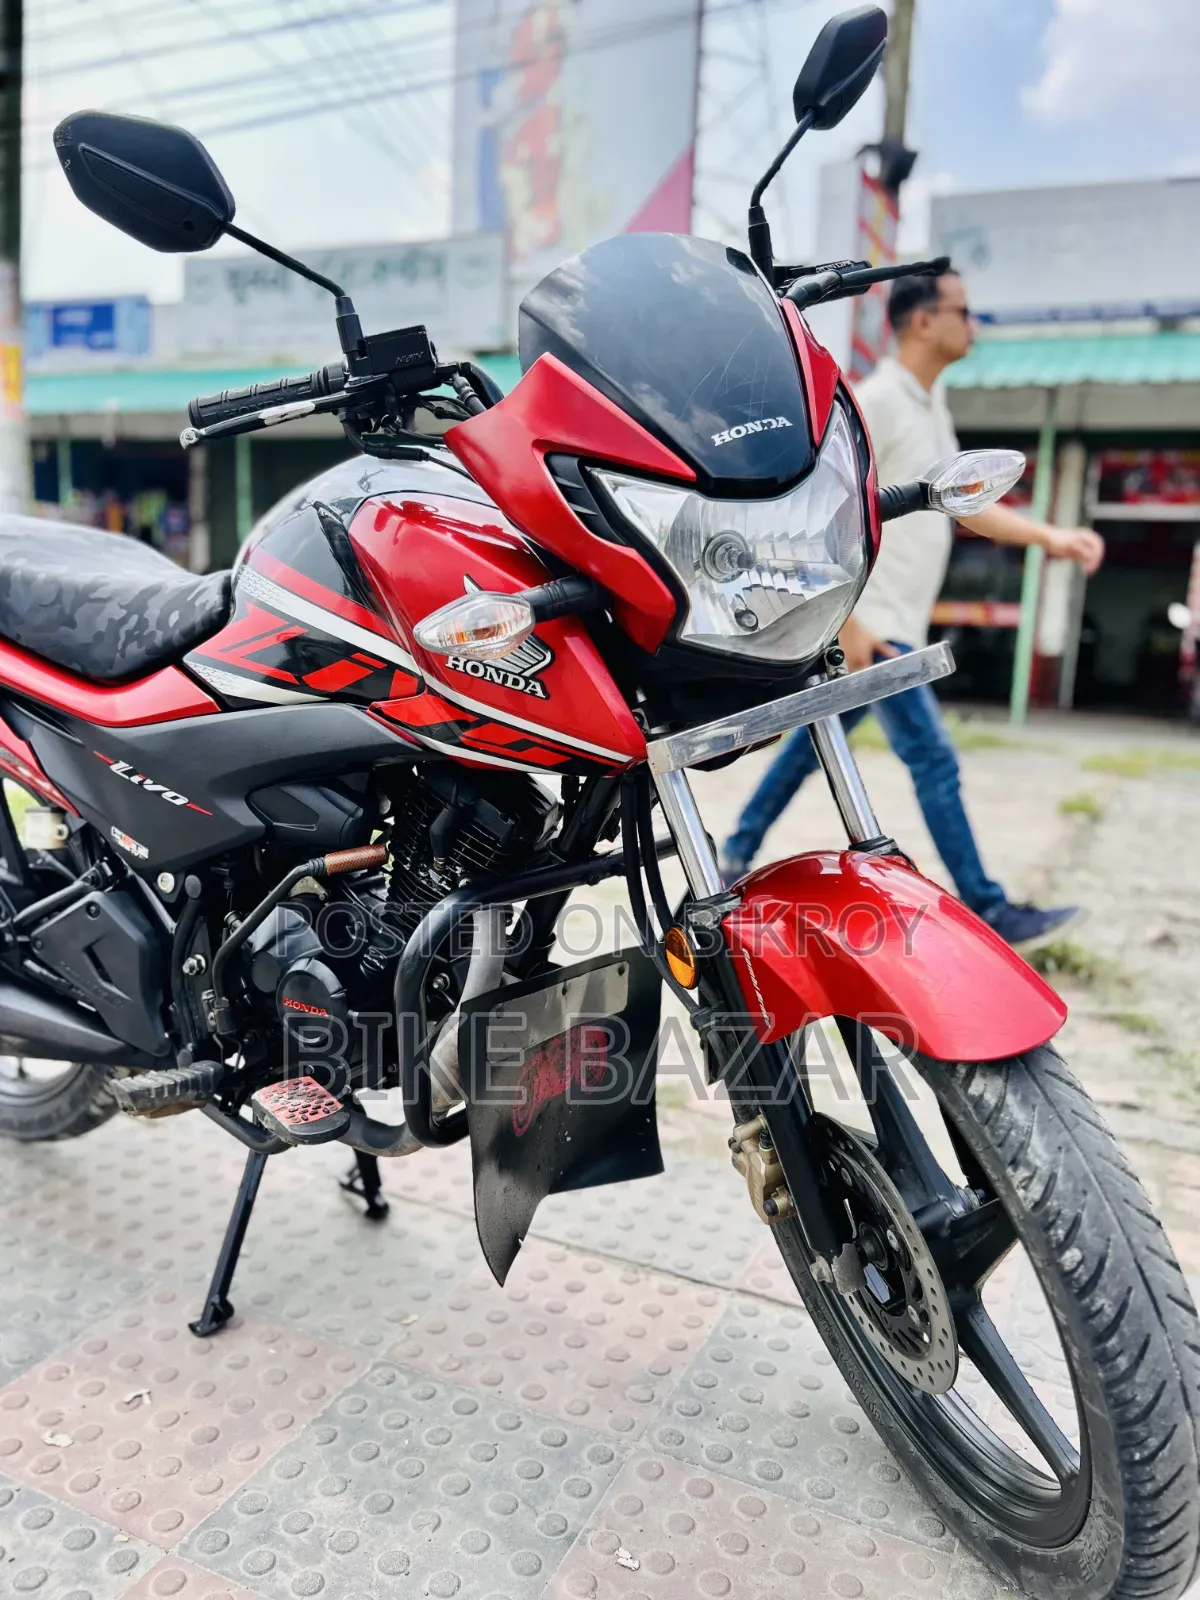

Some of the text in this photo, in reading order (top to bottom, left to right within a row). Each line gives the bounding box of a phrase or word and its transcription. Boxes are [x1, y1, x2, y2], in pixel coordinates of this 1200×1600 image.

[710, 416, 793, 447] HONDA
[445, 655, 547, 699] HONDA
[283, 996, 329, 1018] HONDA
